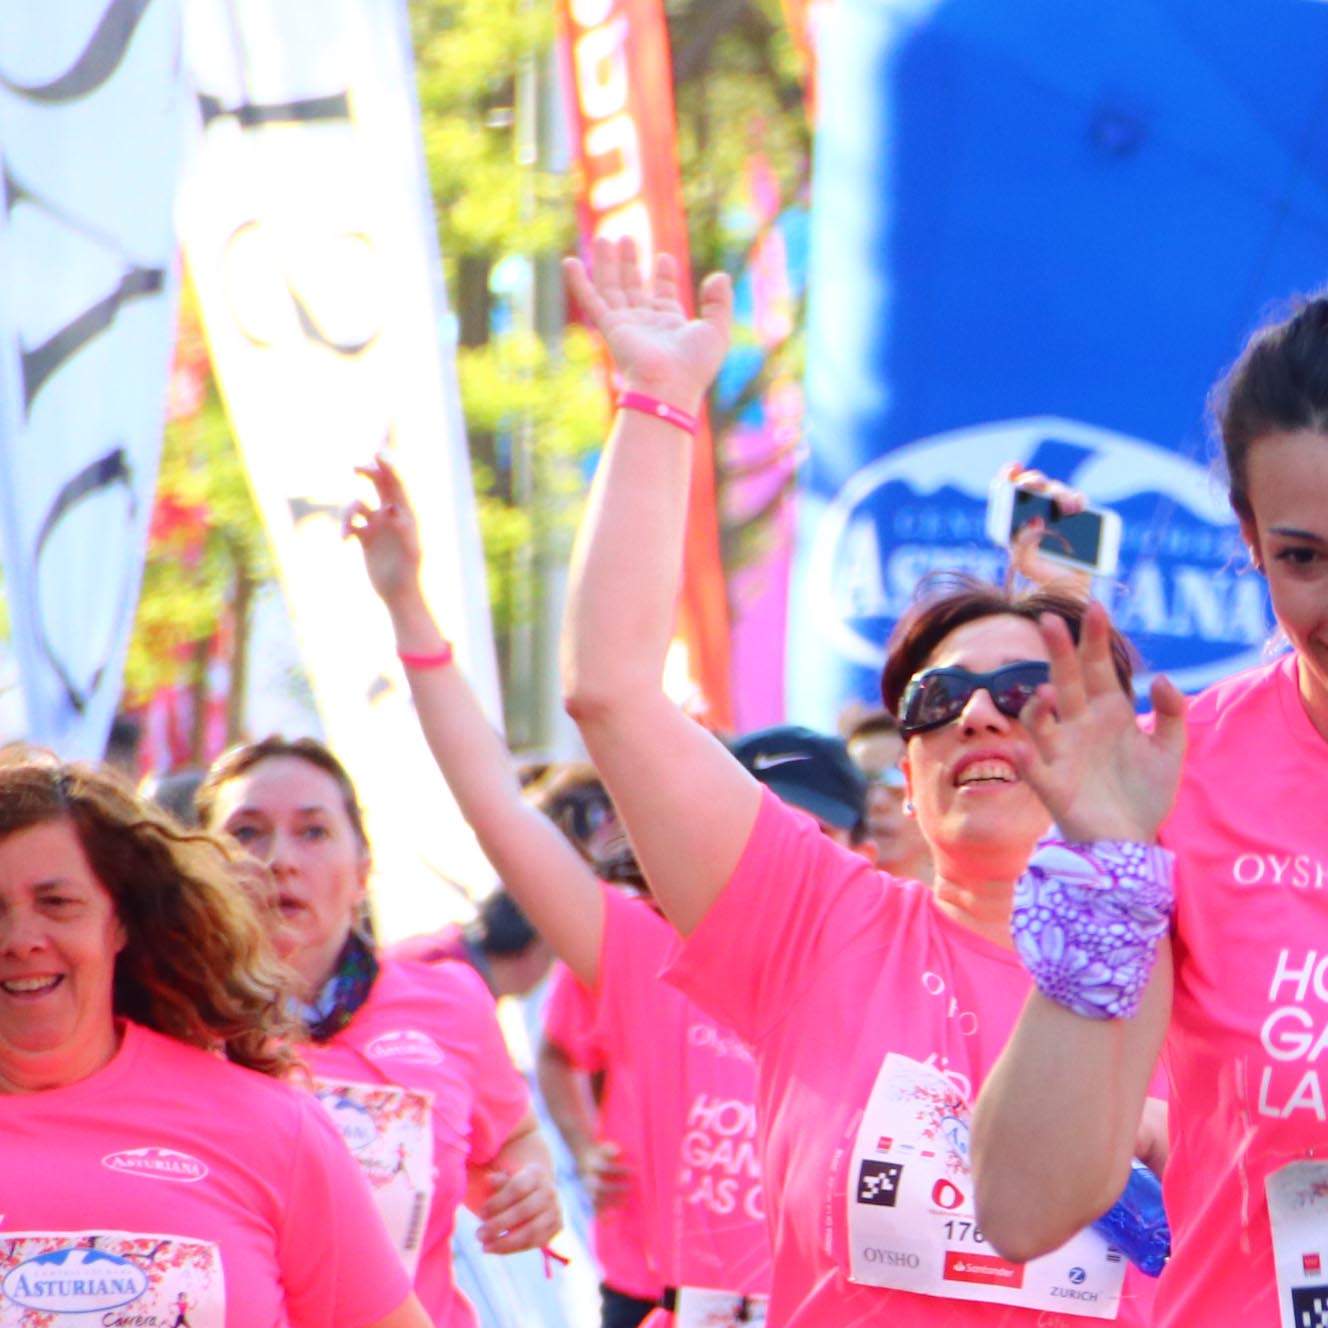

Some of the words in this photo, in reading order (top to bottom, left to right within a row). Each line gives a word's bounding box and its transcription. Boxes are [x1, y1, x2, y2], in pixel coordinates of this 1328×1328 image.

[944, 1220, 984, 1243] 176
[864, 1247, 920, 1269] OYSHO
[965, 1262, 1015, 1278] Santander
[14, 1274, 137, 1298] ASTURIANA
[1050, 1286, 1098, 1302] ZURICH
[102, 1312, 157, 1328] Carrera
